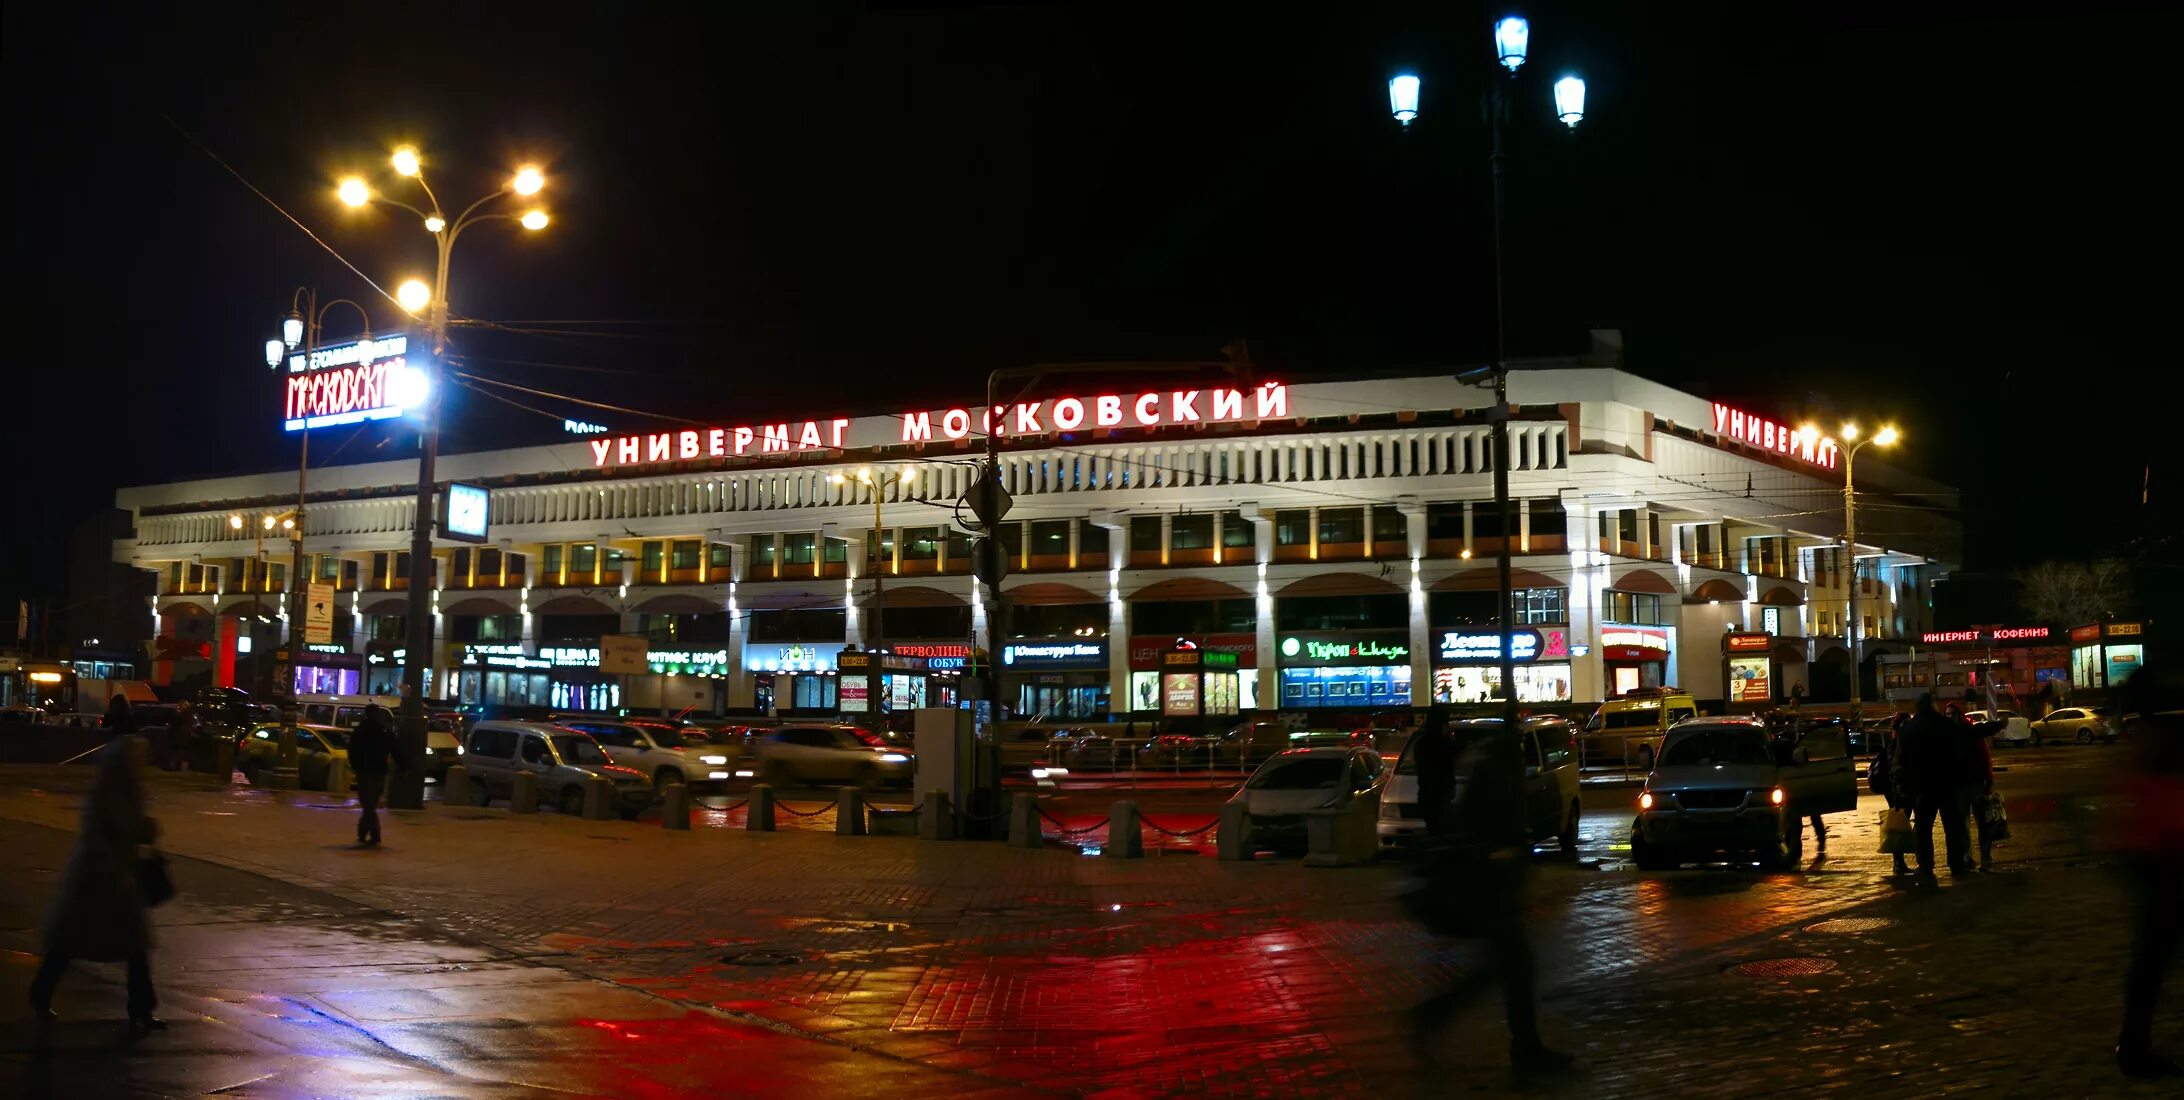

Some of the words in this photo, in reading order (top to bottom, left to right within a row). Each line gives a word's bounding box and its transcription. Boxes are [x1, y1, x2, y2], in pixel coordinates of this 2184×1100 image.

[287, 356, 406, 420] МОСКОВСКИ
[590, 418, 849, 468] УНИВЕРМАГ
[902, 382, 1288, 442] МОСКОВСКИЙ
[1441, 632, 1537, 648] Леонадо
[1549, 631, 1564, 646] 3
[692, 649, 727, 667] клуб
[895, 645, 970, 658] ТЕРВОЛИНА
[1132, 647, 1160, 662] ЦЕН
[934, 658, 966, 668] ОБУВ
[841, 681, 862, 689] ОБУВЬ
[1734, 680, 1741, 689] 3
